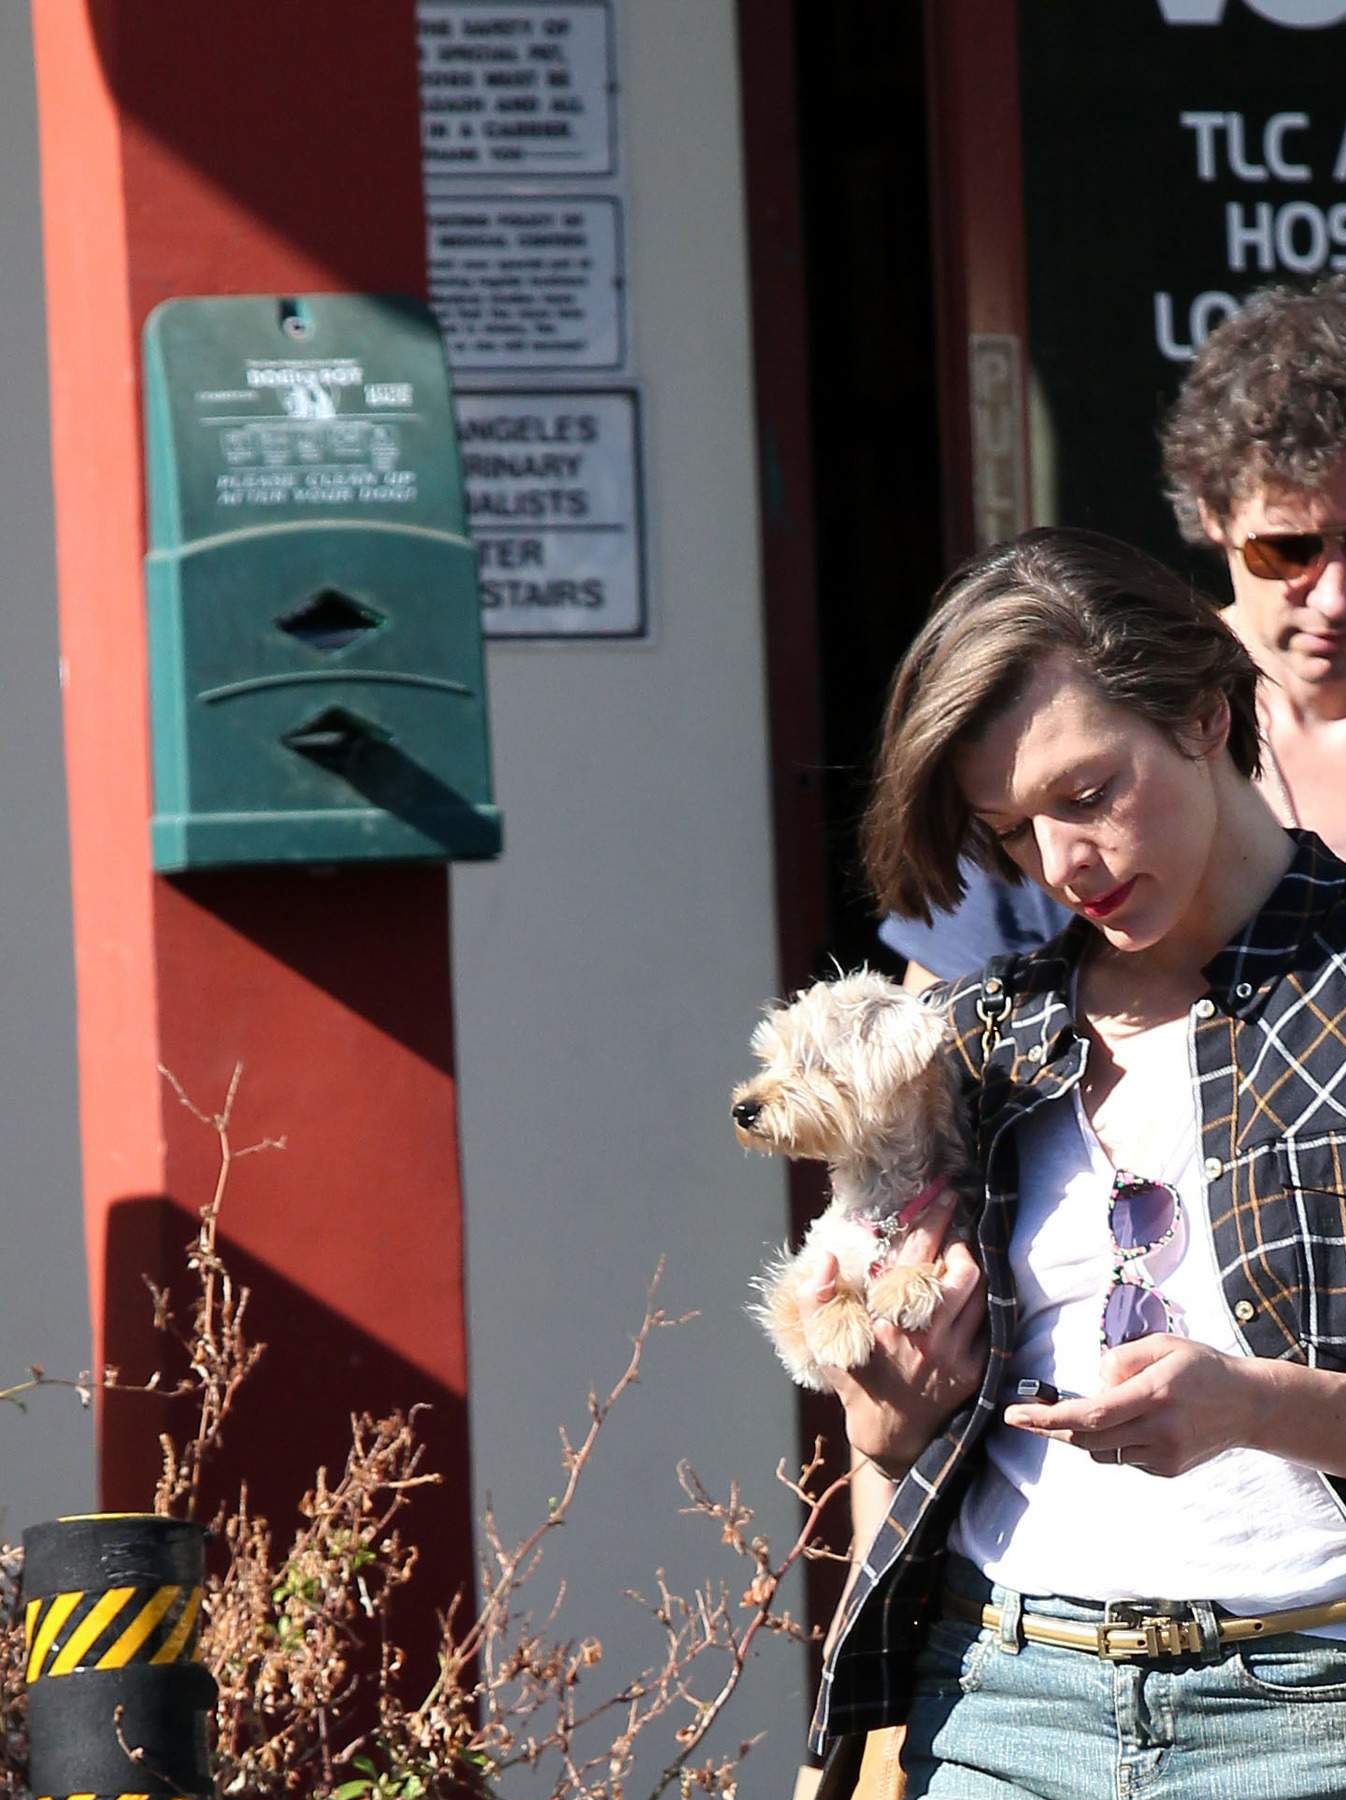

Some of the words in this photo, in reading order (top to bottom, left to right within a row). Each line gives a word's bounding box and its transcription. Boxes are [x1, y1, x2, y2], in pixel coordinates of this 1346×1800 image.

[1180, 111, 1312, 182] TLC
[1154, 292, 1240, 362] LO
[462, 453, 581, 477] RINARY
[465, 489, 590, 517] IALISTS
[479, 578, 606, 610] STAIRS
